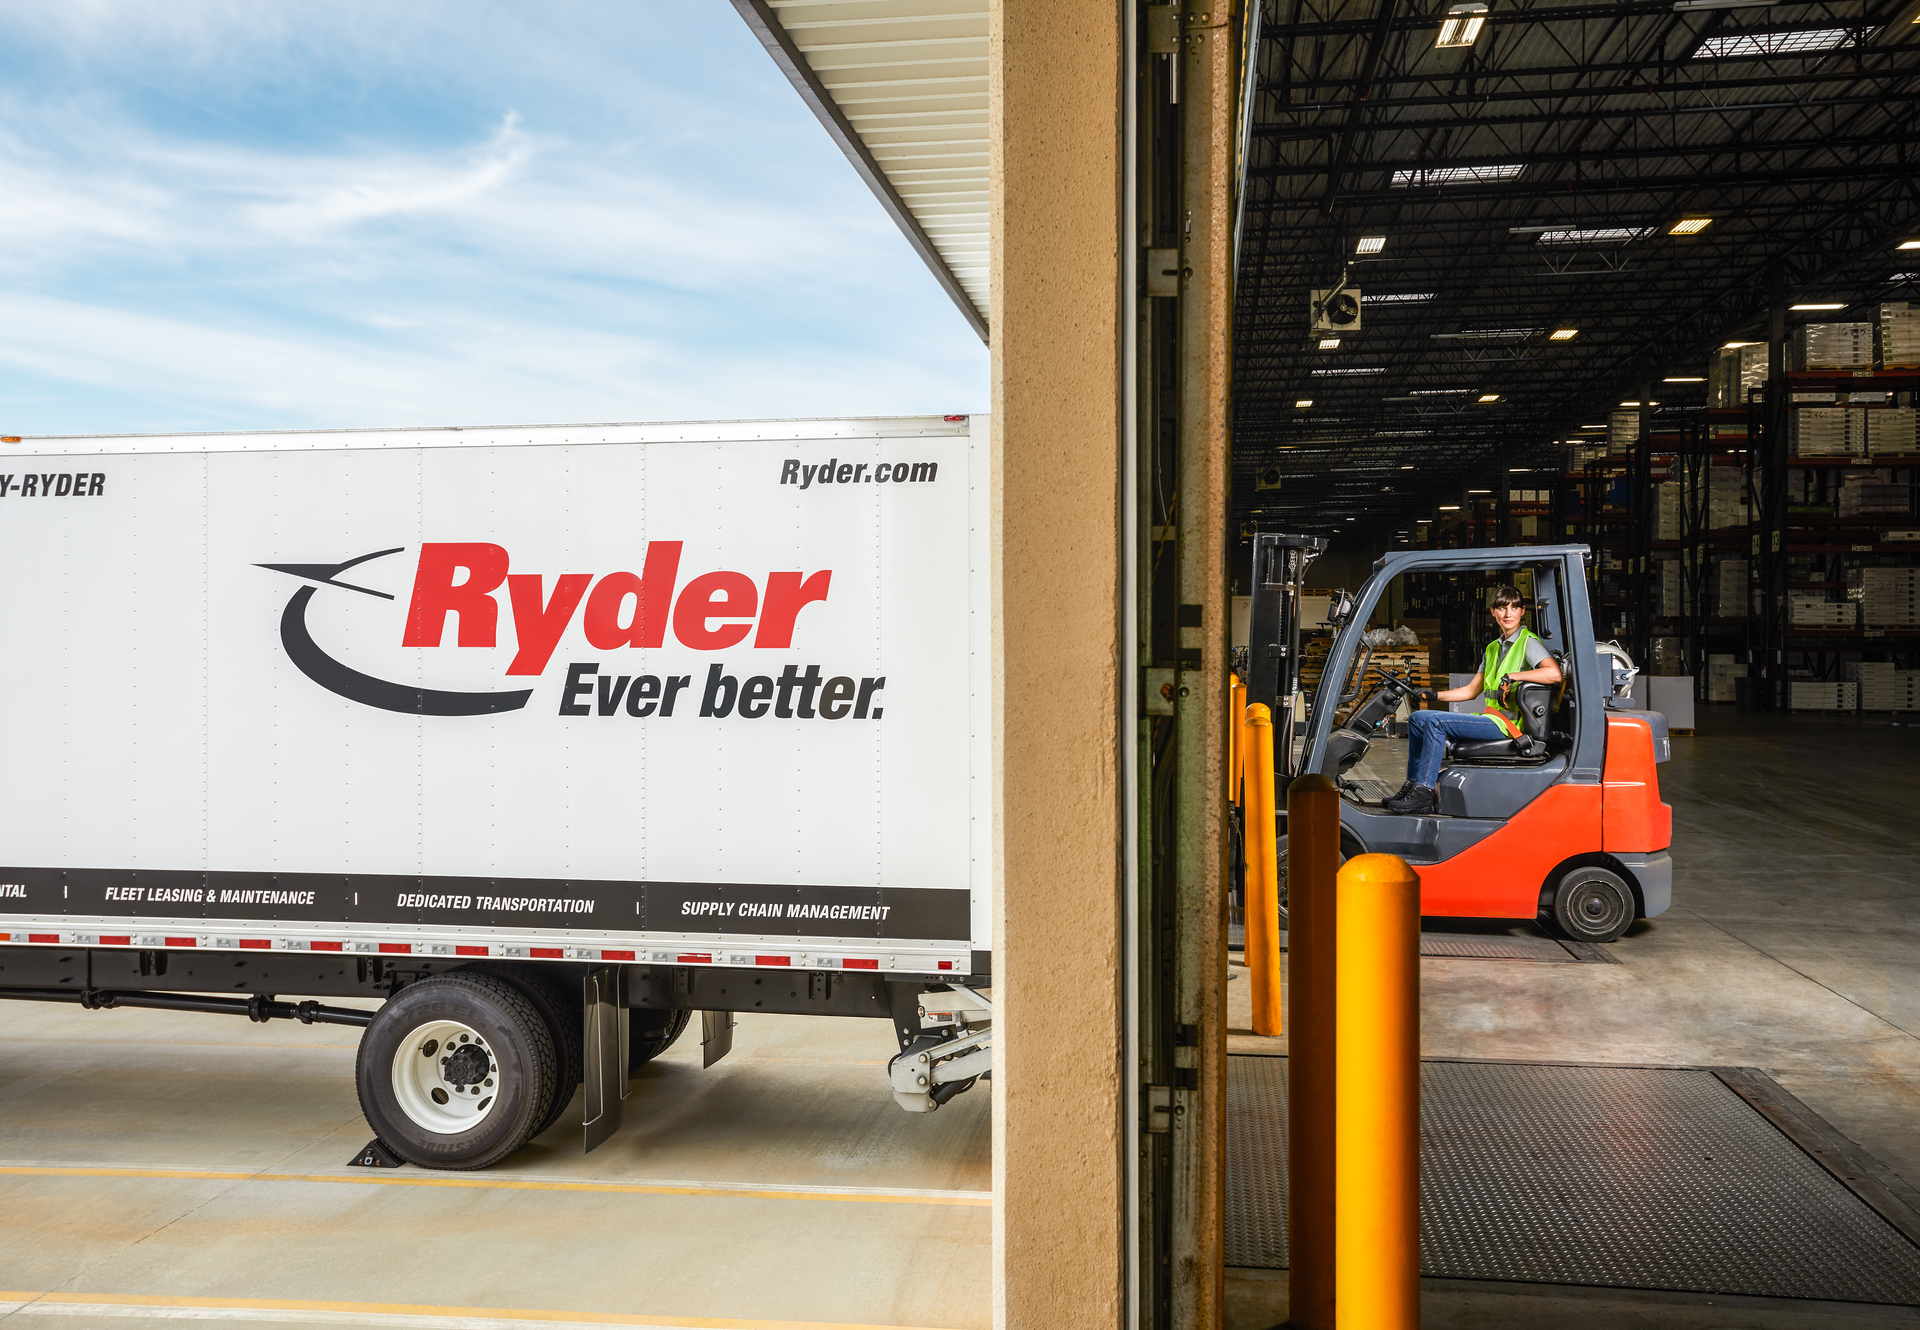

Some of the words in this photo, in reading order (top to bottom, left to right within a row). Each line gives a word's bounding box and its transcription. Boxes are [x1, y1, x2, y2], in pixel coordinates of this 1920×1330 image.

[779, 459, 938, 490] Ryder.com
[0, 473, 106, 497] Y-RYDER
[1752, 537, 1759, 550] 14
[1772, 533, 1779, 546] 13
[402, 541, 832, 676] Ryder
[559, 663, 692, 718] Ever
[699, 664, 887, 720] better.
[105, 887, 145, 901] FLEET
[147, 888, 203, 903] LEASING
[206, 890, 217, 903] &
[220, 890, 315, 905] MAINTENANCE
[397, 894, 472, 909] DEDICATED
[477, 897, 595, 914] TRANSPORTATION
[682, 902, 736, 917] SUPPLY
[739, 903, 784, 918] CHAIN
[787, 904, 891, 920] MANAGEMENT
